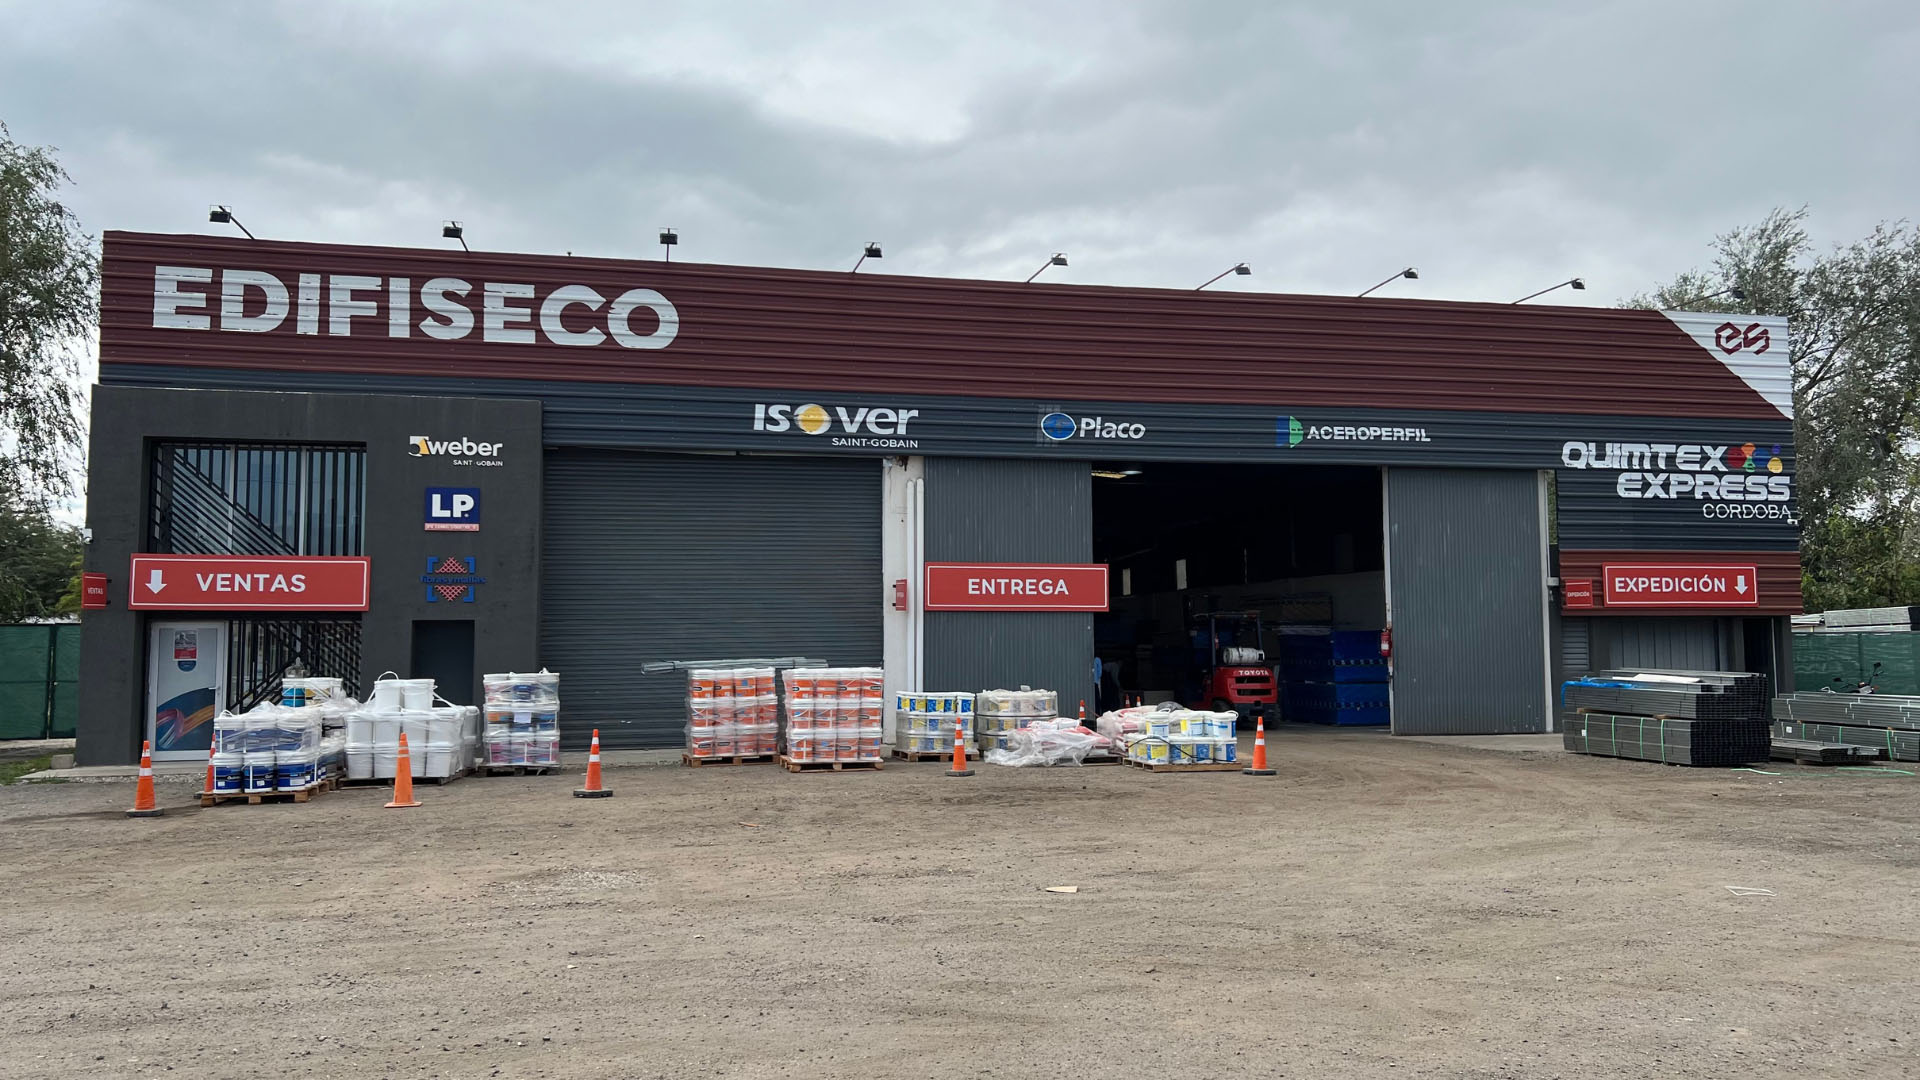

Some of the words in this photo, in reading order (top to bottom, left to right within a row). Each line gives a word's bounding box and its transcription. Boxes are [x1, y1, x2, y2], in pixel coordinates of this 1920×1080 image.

[152, 265, 679, 349] EDIFISECO
[1079, 416, 1146, 439] Placo
[1307, 426, 1431, 442] ACEROPERFIL
[428, 437, 503, 457] weber
[832, 437, 918, 449] SAINT-GOBAIN
[1561, 441, 1728, 471] QUIMTEX
[1617, 472, 1790, 501] EXPRESS
[1702, 503, 1791, 519] CORDOBA
[196, 573, 306, 593] VENTAS
[968, 578, 1069, 595] ENTREGA
[1615, 574, 1726, 593] EXPEDICIÓN
